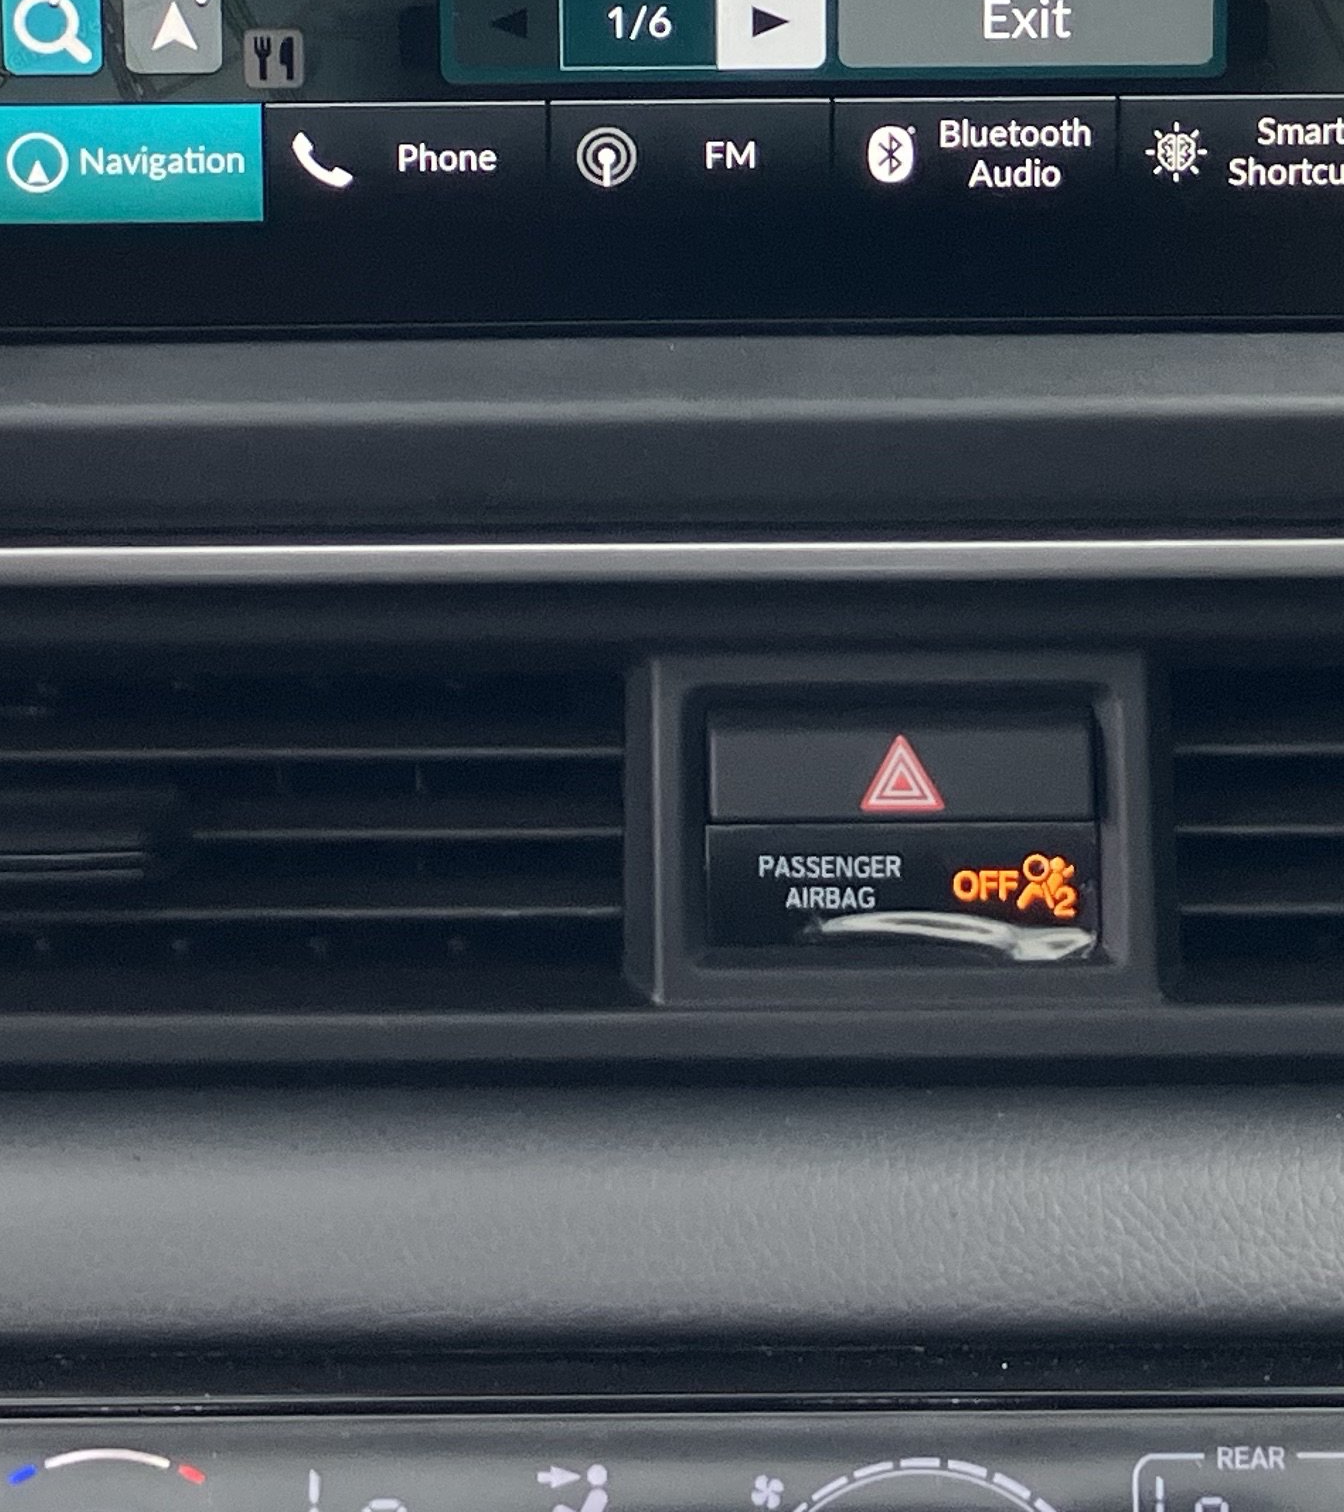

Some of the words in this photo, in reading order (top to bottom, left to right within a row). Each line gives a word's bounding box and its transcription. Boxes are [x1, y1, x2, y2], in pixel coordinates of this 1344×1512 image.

[607, 4, 673, 42] 1/6
[940, 117, 1093, 148] Bluetooth
[79, 145, 245, 181] Navigation
[398, 142, 498, 172] Phone
[704, 140, 757, 170] FM
[968, 158, 1062, 188] Audio
[758, 855, 902, 879] PASSENGER
[785, 886, 877, 910] AIRBAG
[952, 869, 1020, 902] OFF
[1216, 1445, 1287, 1471] REAR
